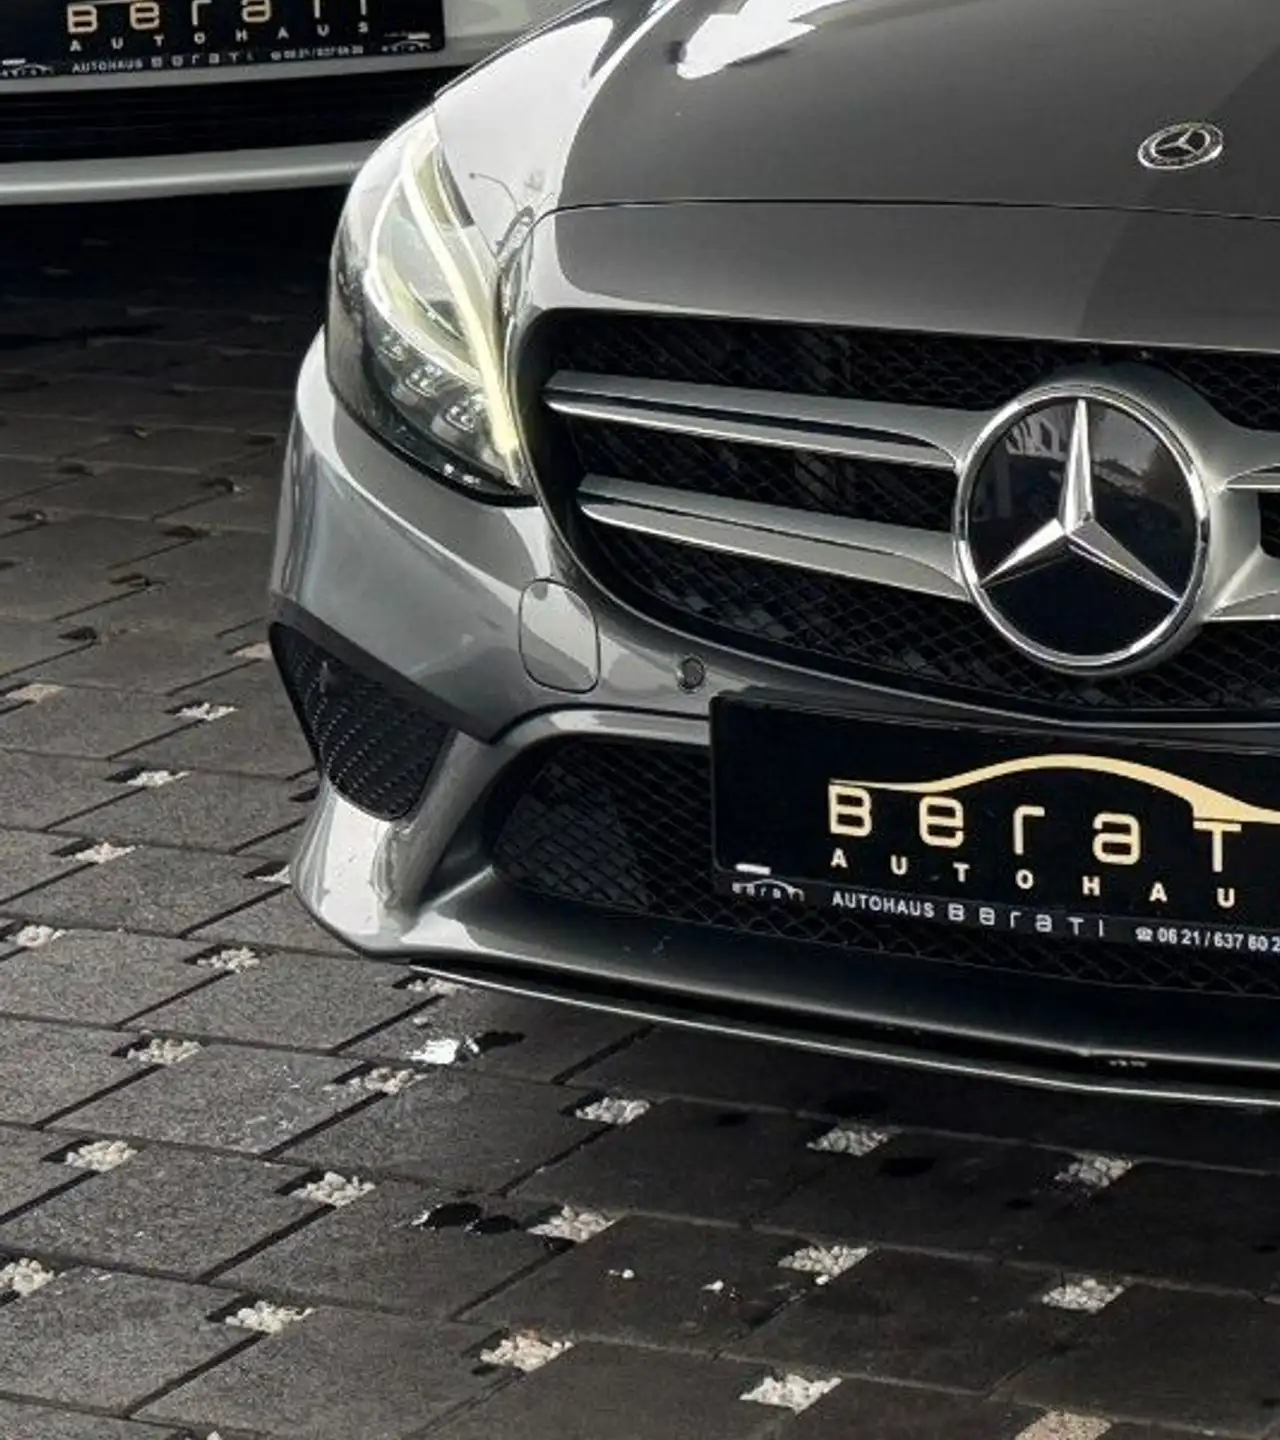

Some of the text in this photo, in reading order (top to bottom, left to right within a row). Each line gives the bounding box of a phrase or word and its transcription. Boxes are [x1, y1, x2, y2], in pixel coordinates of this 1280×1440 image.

[69, 22, 369, 52] AUTOHAUS
[831, 890, 935, 918] AUTOHAUS
[1156, 926, 1178, 945] 06
[1181, 928, 1201, 946] 21
[1213, 931, 1245, 950] 637
